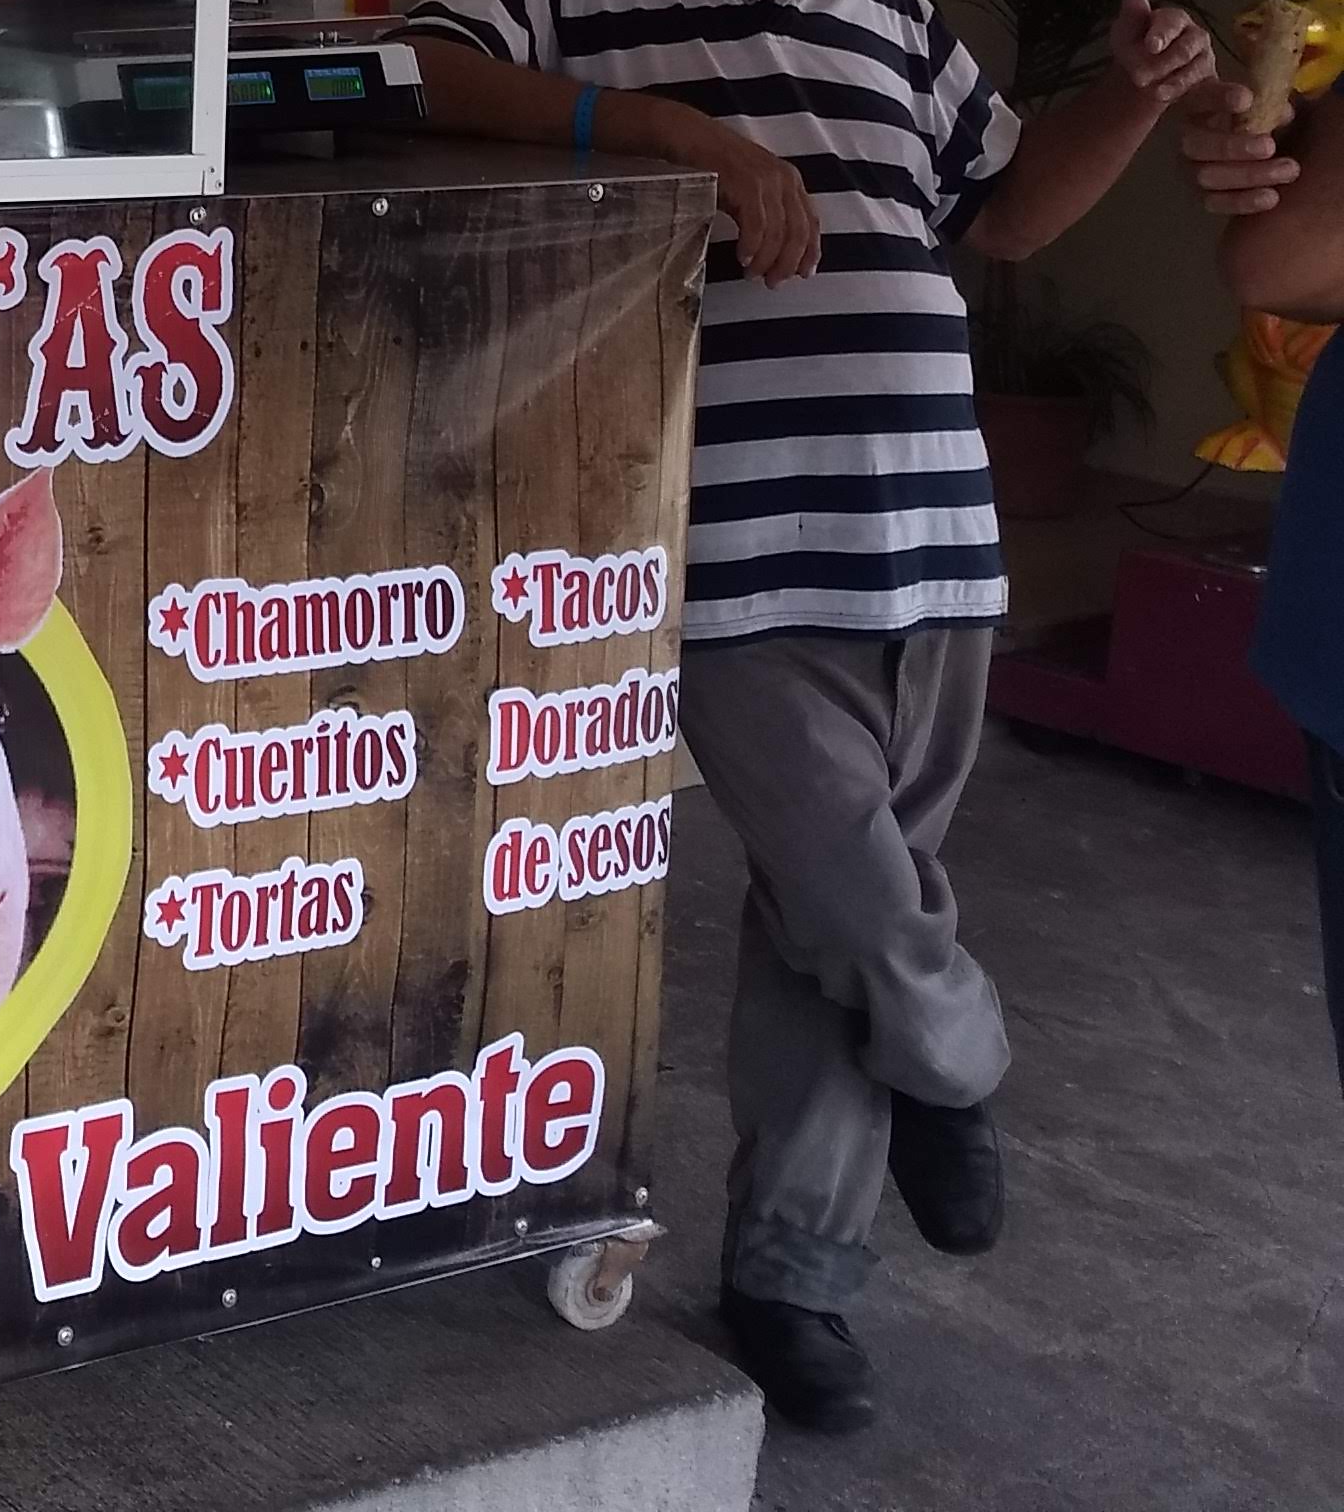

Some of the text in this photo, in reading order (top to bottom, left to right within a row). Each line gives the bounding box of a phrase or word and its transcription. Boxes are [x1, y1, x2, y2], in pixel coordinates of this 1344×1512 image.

[191, 574, 456, 671] Chamorro
[532, 552, 662, 636] Tacos
[191, 718, 410, 816] Cueritos
[495, 679, 679, 773] Dorados
[490, 805, 671, 904] de sesos
[190, 866, 356, 960] Tortas
[18, 1041, 596, 1291] Valiente
